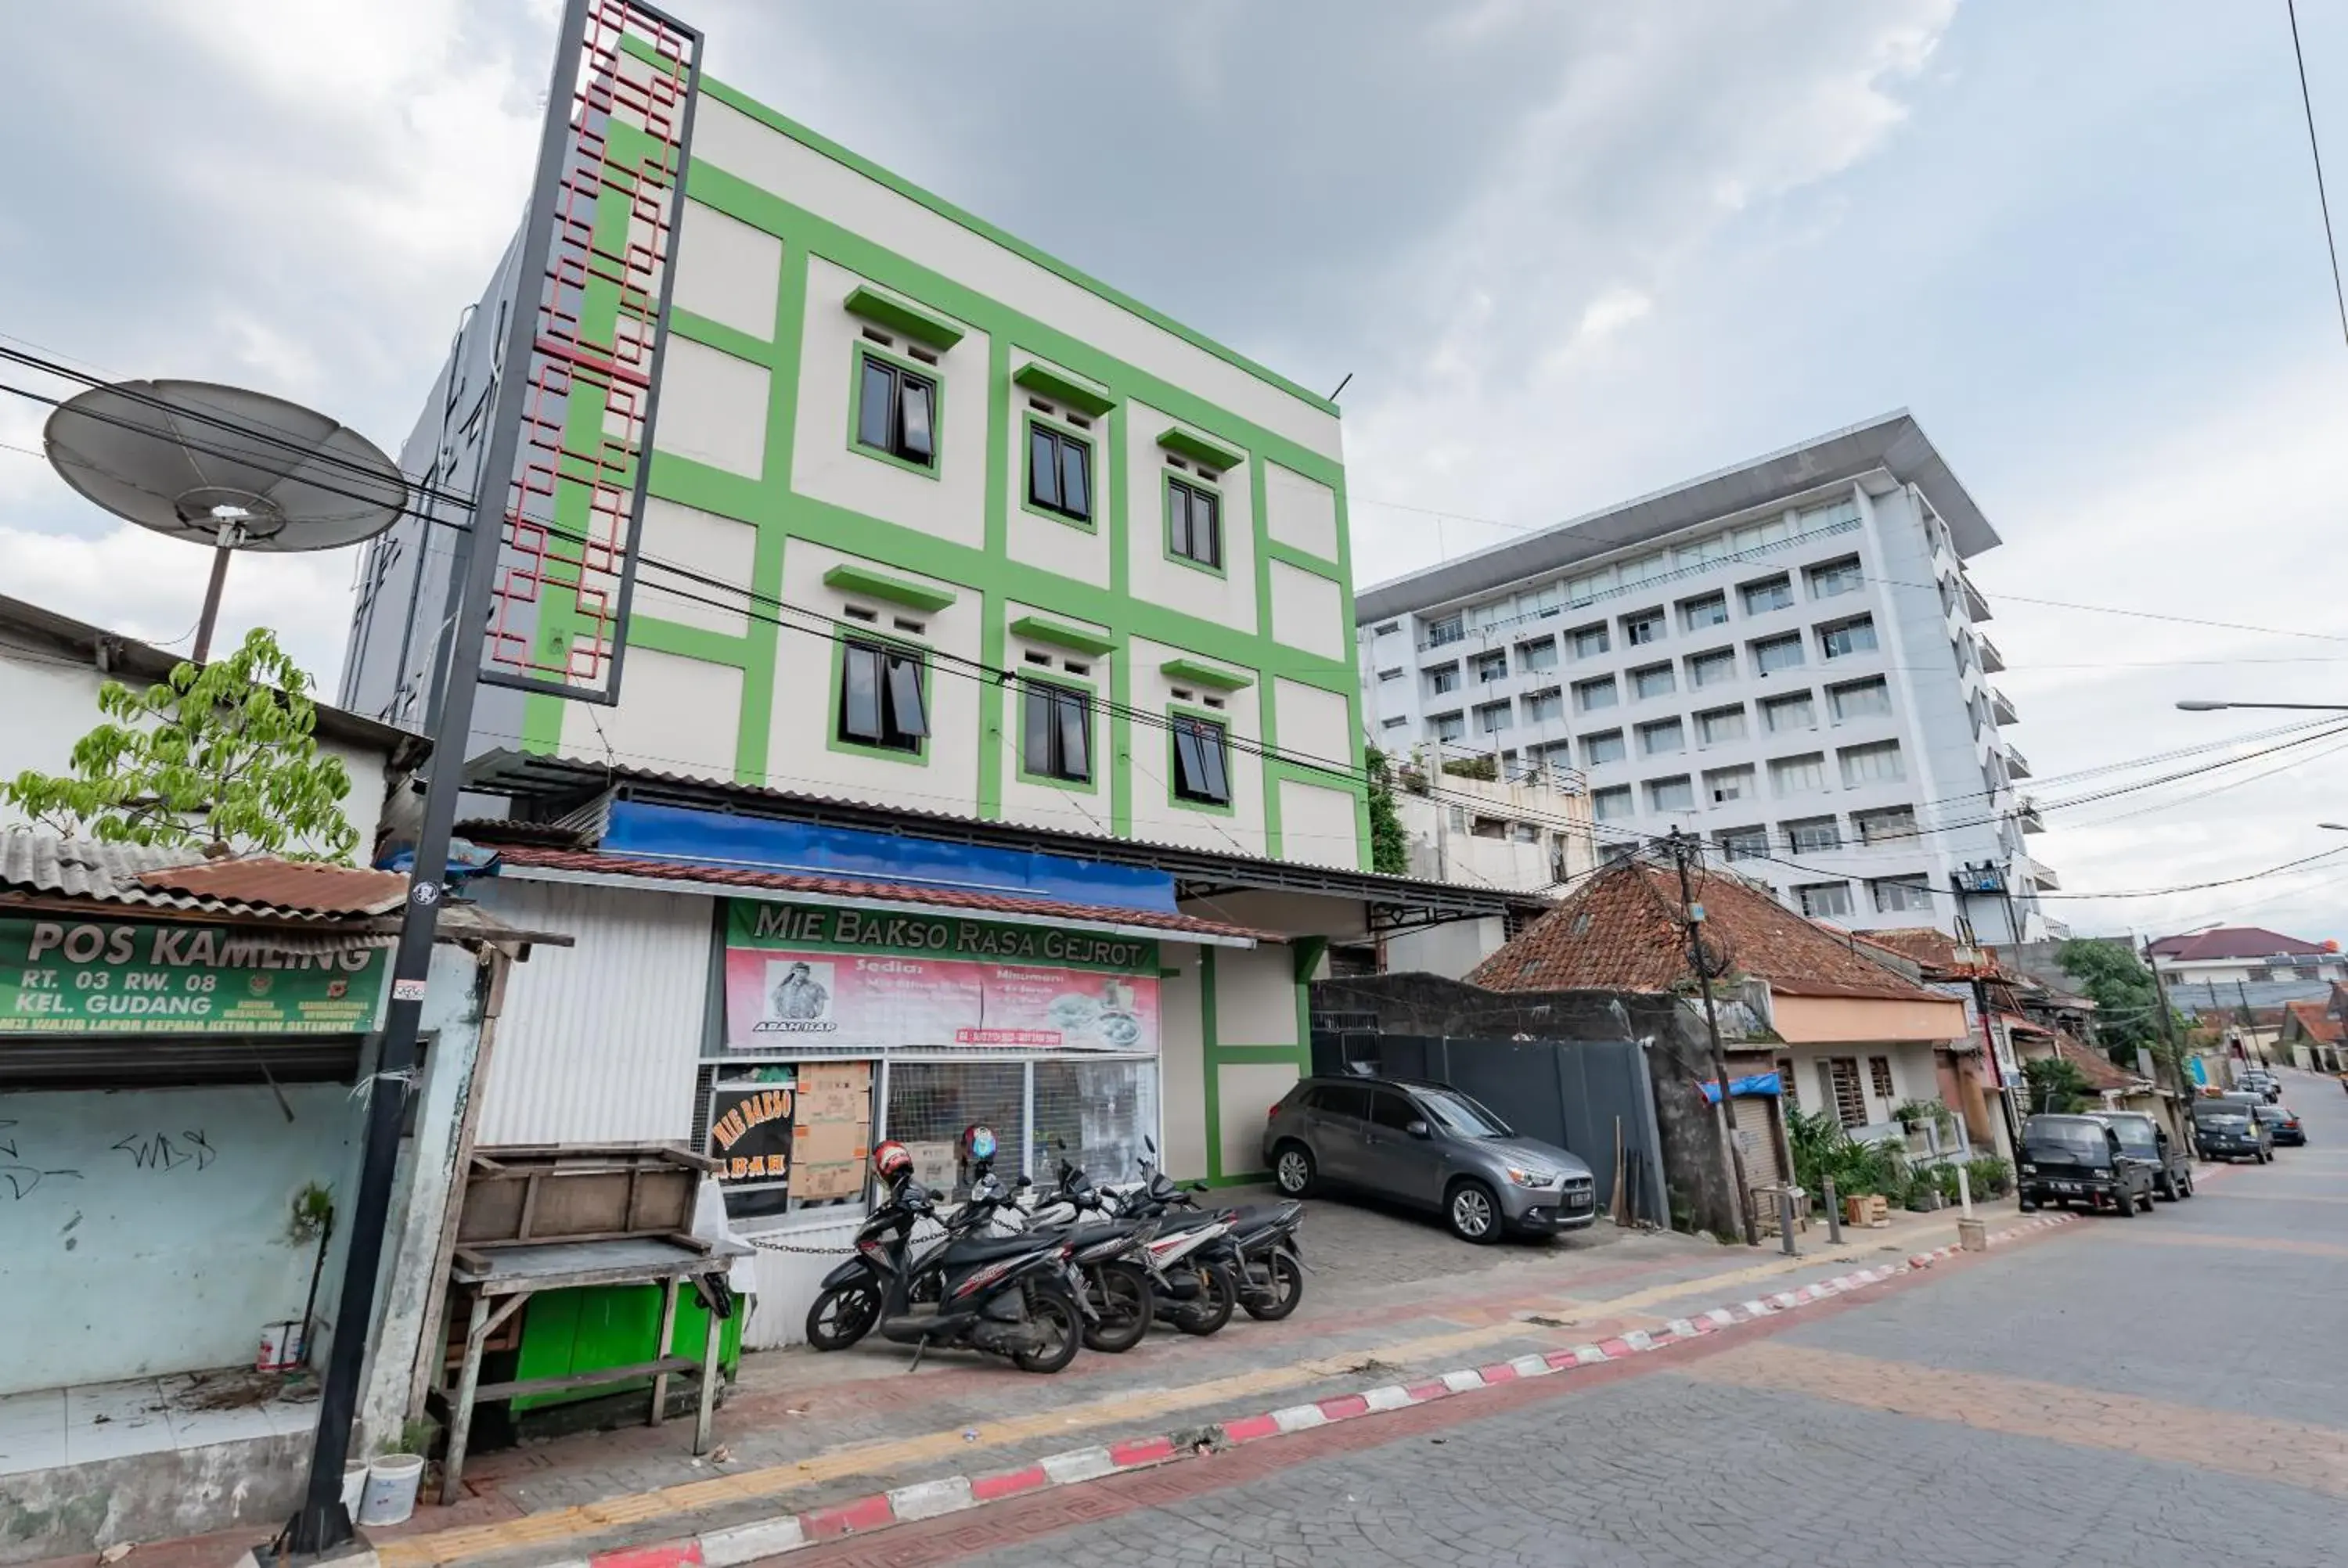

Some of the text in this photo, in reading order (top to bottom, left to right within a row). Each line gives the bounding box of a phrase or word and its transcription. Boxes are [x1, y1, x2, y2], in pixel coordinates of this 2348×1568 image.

[27, 922, 136, 965] POS
[754, 904, 1141, 966] MIE BAKSO RASA GEJROT
[21, 969, 216, 992] RT. 03 RW. 08
[16, 992, 74, 1013] KEL.
[85, 994, 212, 1015] GUDANG
[712, 1108, 747, 1151] MIE
